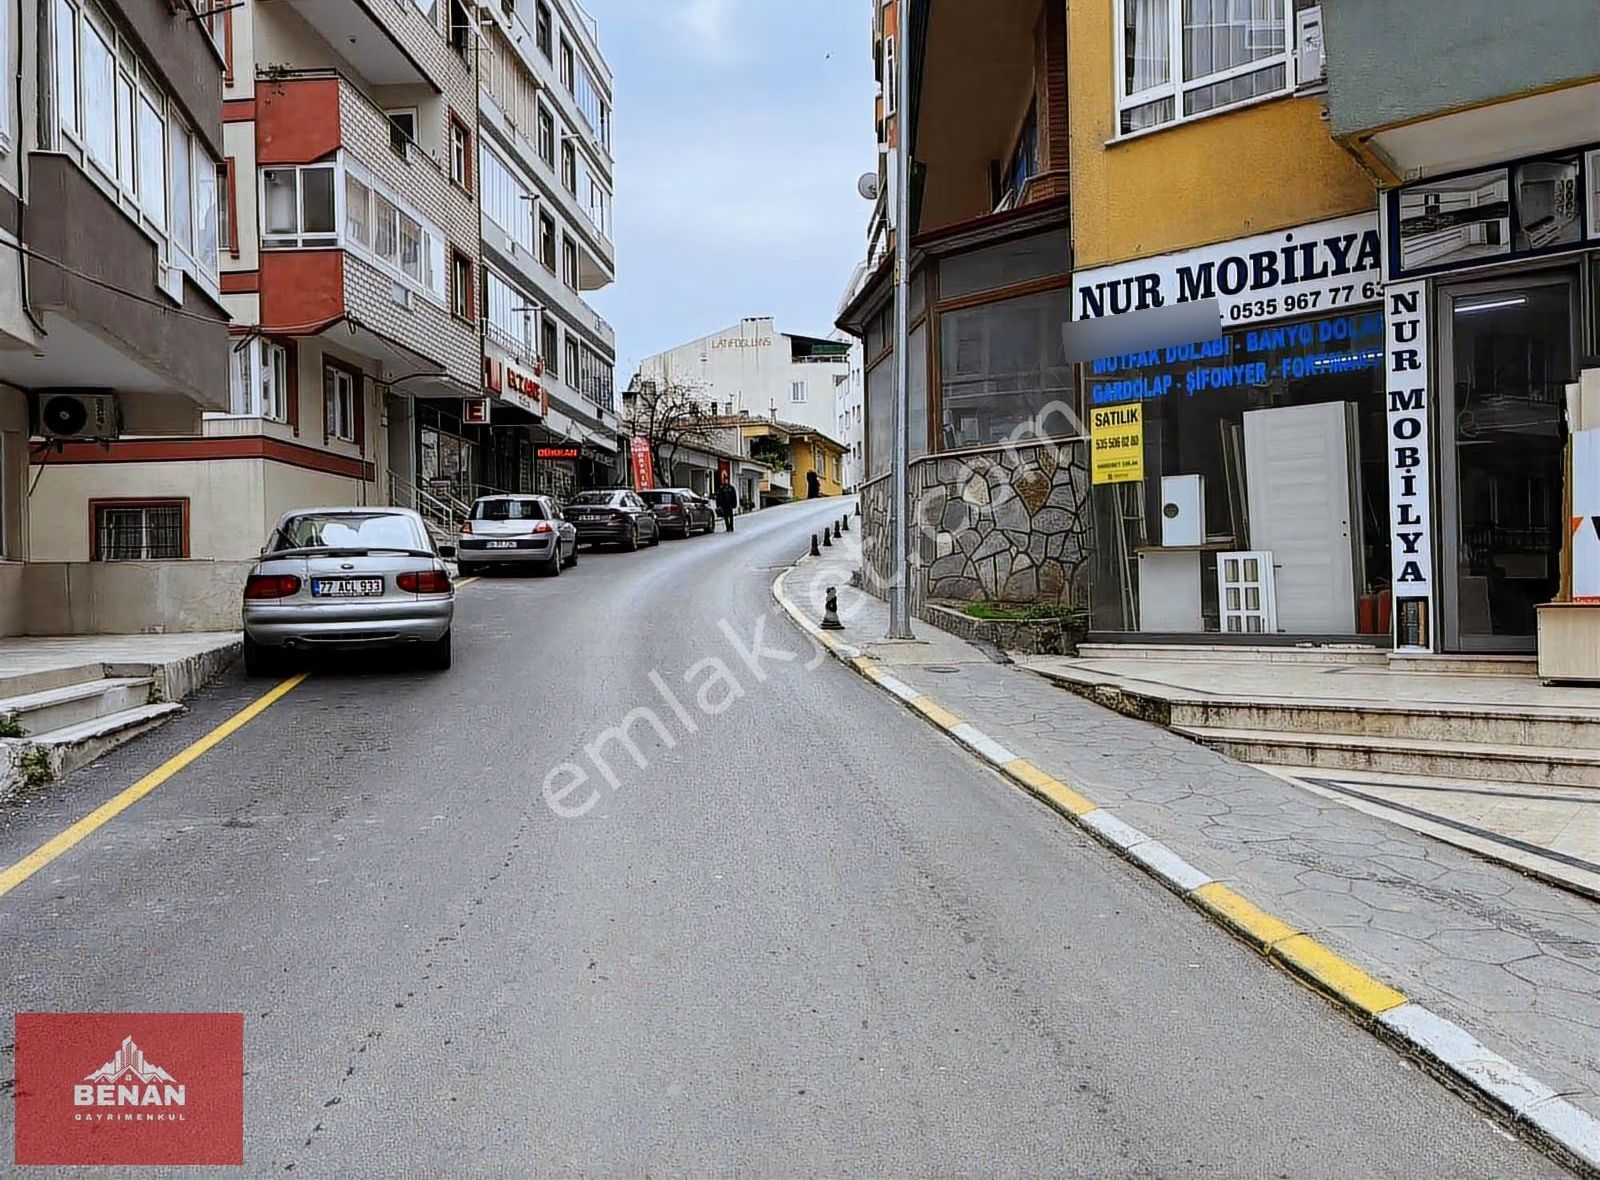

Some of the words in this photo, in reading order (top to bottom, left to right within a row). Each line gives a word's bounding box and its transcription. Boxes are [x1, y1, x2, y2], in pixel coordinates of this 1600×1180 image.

[1079, 273, 1165, 320] NUR
[1176, 230, 1381, 303] MOBİLYA
[1230, 299, 1277, 320] 0535
[1284, 291, 1321, 311] 967
[1329, 285, 1354, 304] 77
[1362, 281, 1385, 299] 63
[1246, 323, 1313, 352] BANYO
[1390, 291, 1422, 372] NUR
[1092, 375, 1173, 403] GARDOLAP
[1186, 361, 1267, 396] ŞİFONYER
[1095, 408, 1138, 427] SATILIK
[1389, 388, 1426, 582] MOBİLYA
[320, 581, 333, 592] 77
[338, 581, 354, 592] ACL
[360, 580, 380, 591] 933
